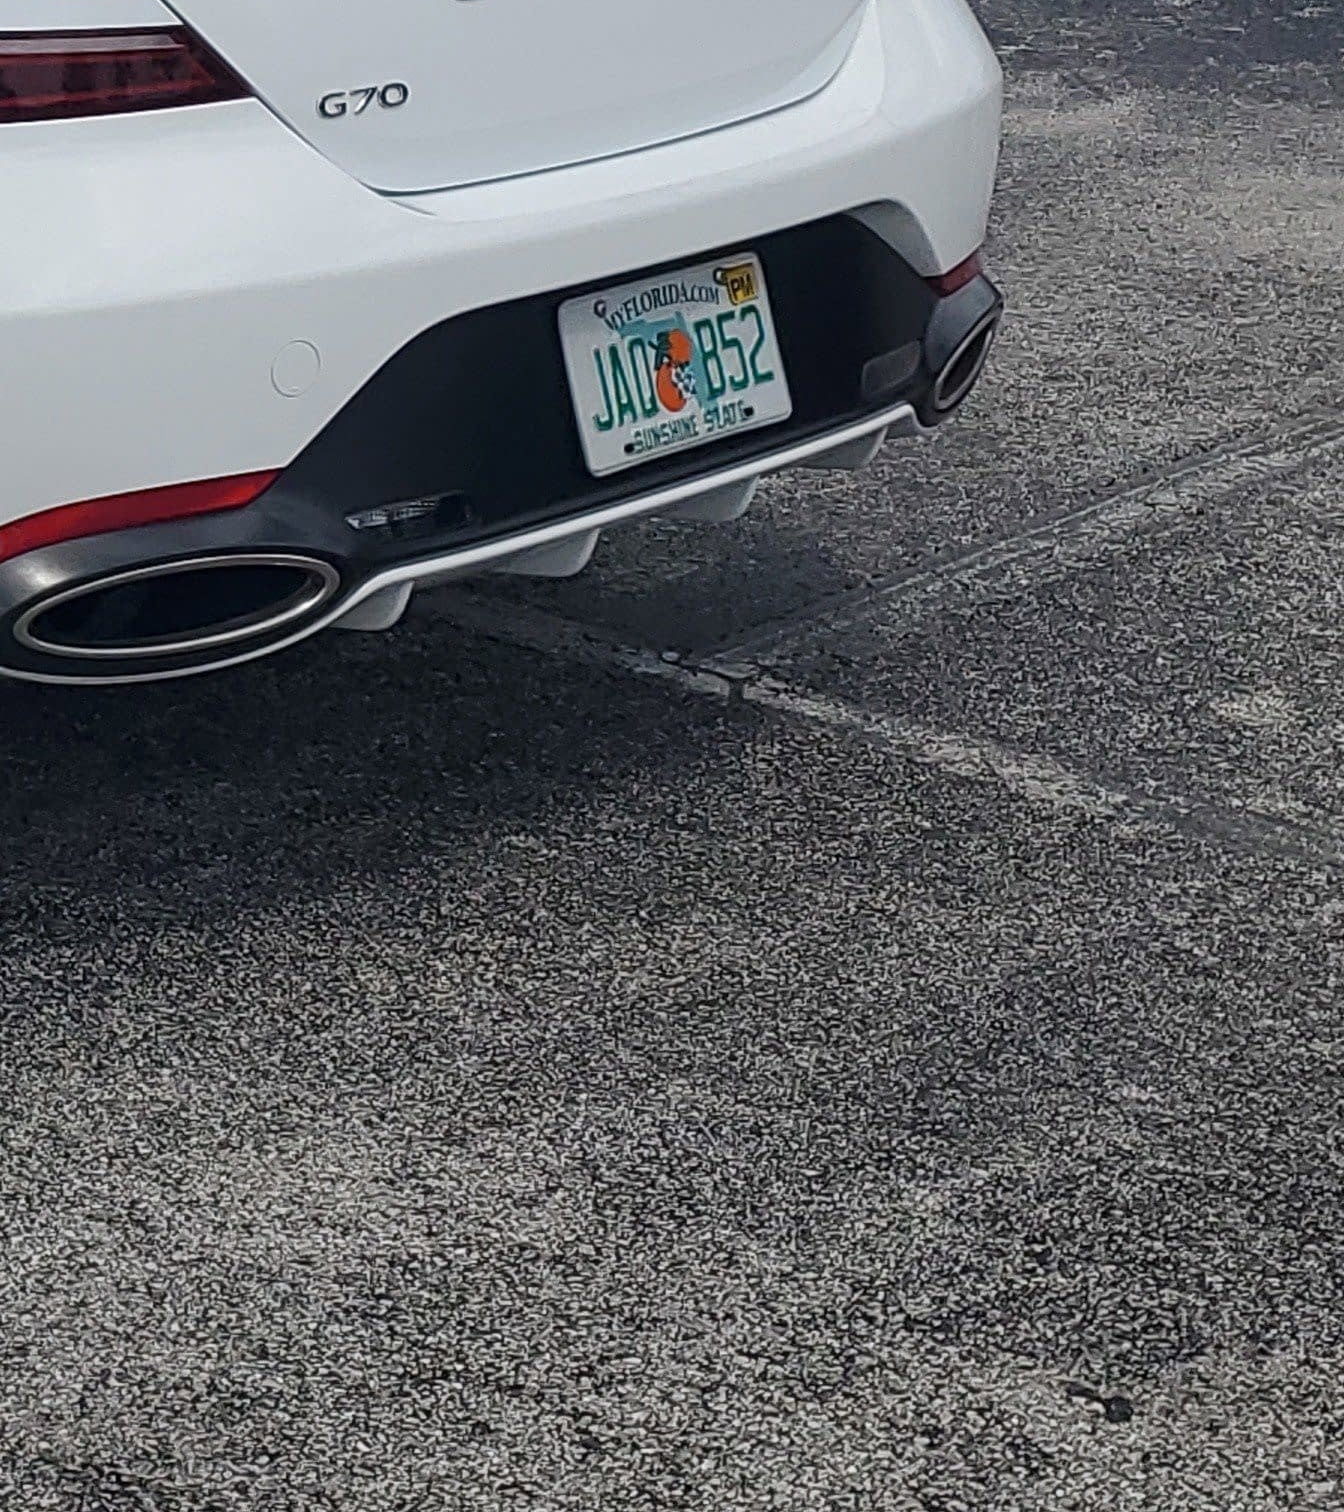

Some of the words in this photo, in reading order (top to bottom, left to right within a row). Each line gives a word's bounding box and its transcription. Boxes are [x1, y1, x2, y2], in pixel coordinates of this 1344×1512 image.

[316, 82, 409, 119] G70
[693, 304, 775, 401] B52
[634, 415, 699, 454] SUNSHINE
[703, 400, 747, 433] STATE
